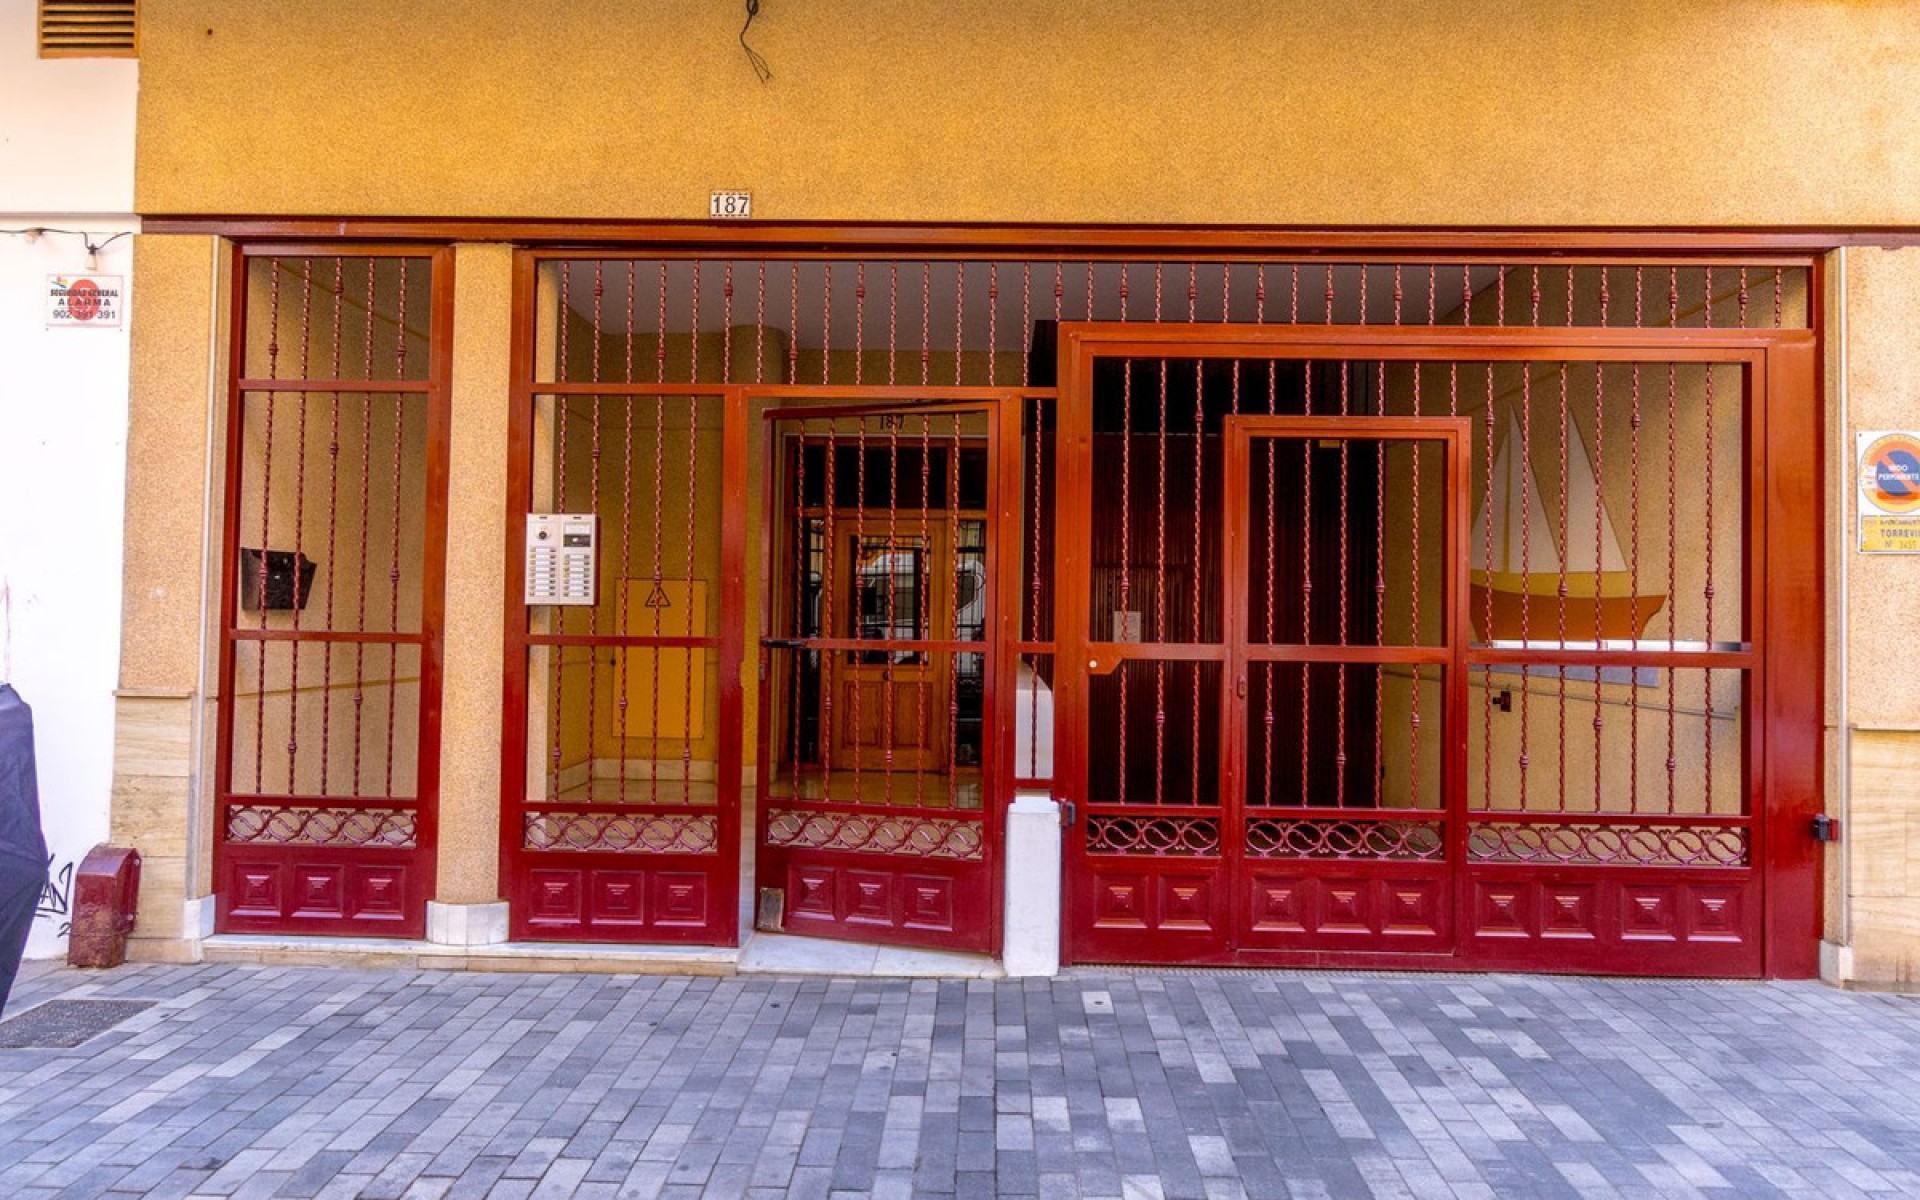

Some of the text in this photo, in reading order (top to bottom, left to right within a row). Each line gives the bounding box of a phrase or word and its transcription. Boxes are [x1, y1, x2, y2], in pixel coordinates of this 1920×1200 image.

[712, 195, 749, 214] 187
[58, 298, 111, 306] ALARMA
[53, 310, 72, 319] 902
[97, 310, 116, 319] 391
[880, 414, 905, 430] 187
